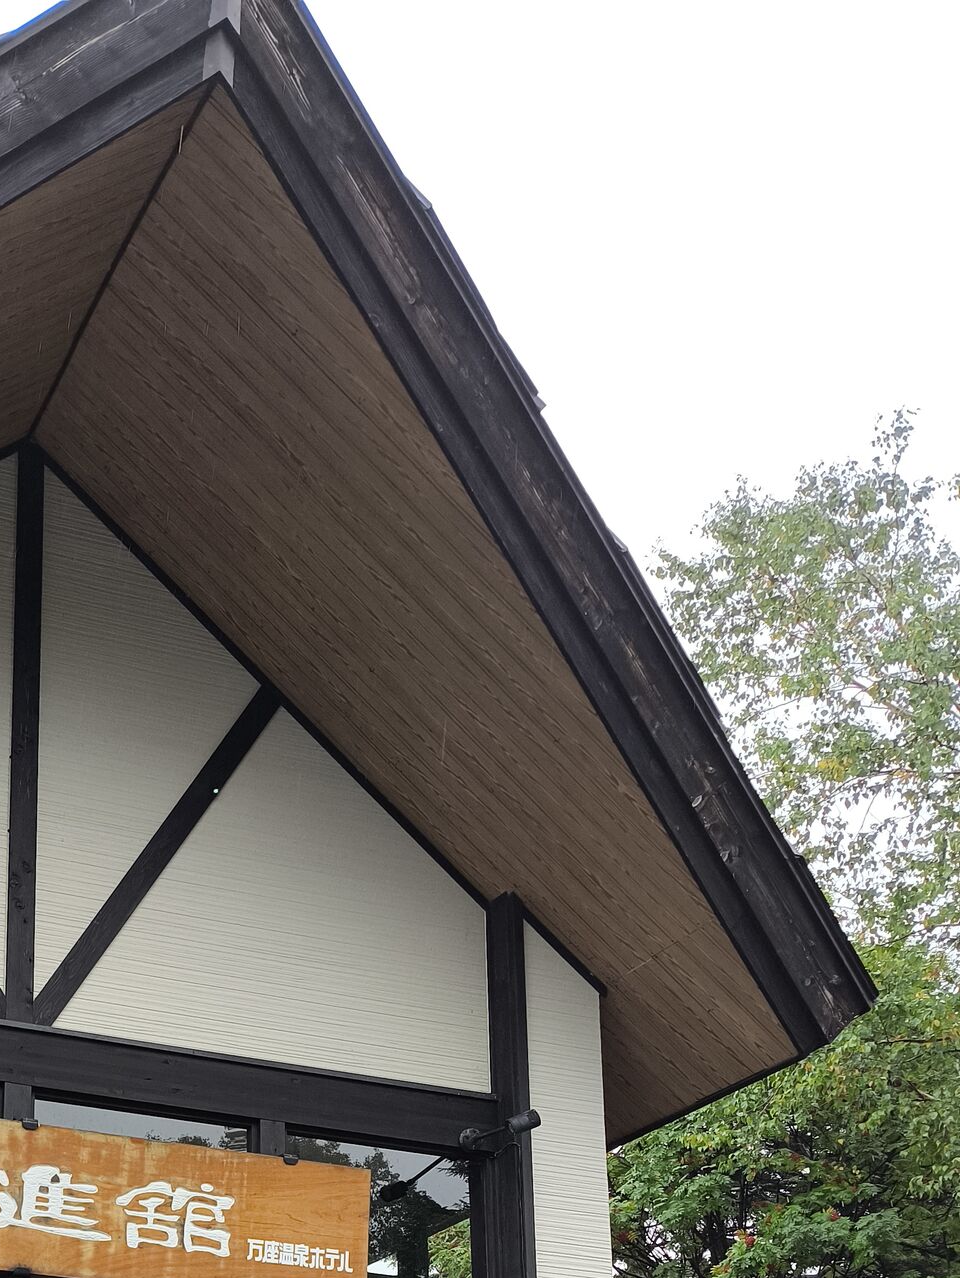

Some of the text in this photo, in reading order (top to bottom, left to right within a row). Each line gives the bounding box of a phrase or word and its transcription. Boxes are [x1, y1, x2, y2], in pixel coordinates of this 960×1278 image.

[246, 1238, 354, 1273] 万座温泉ホテル
